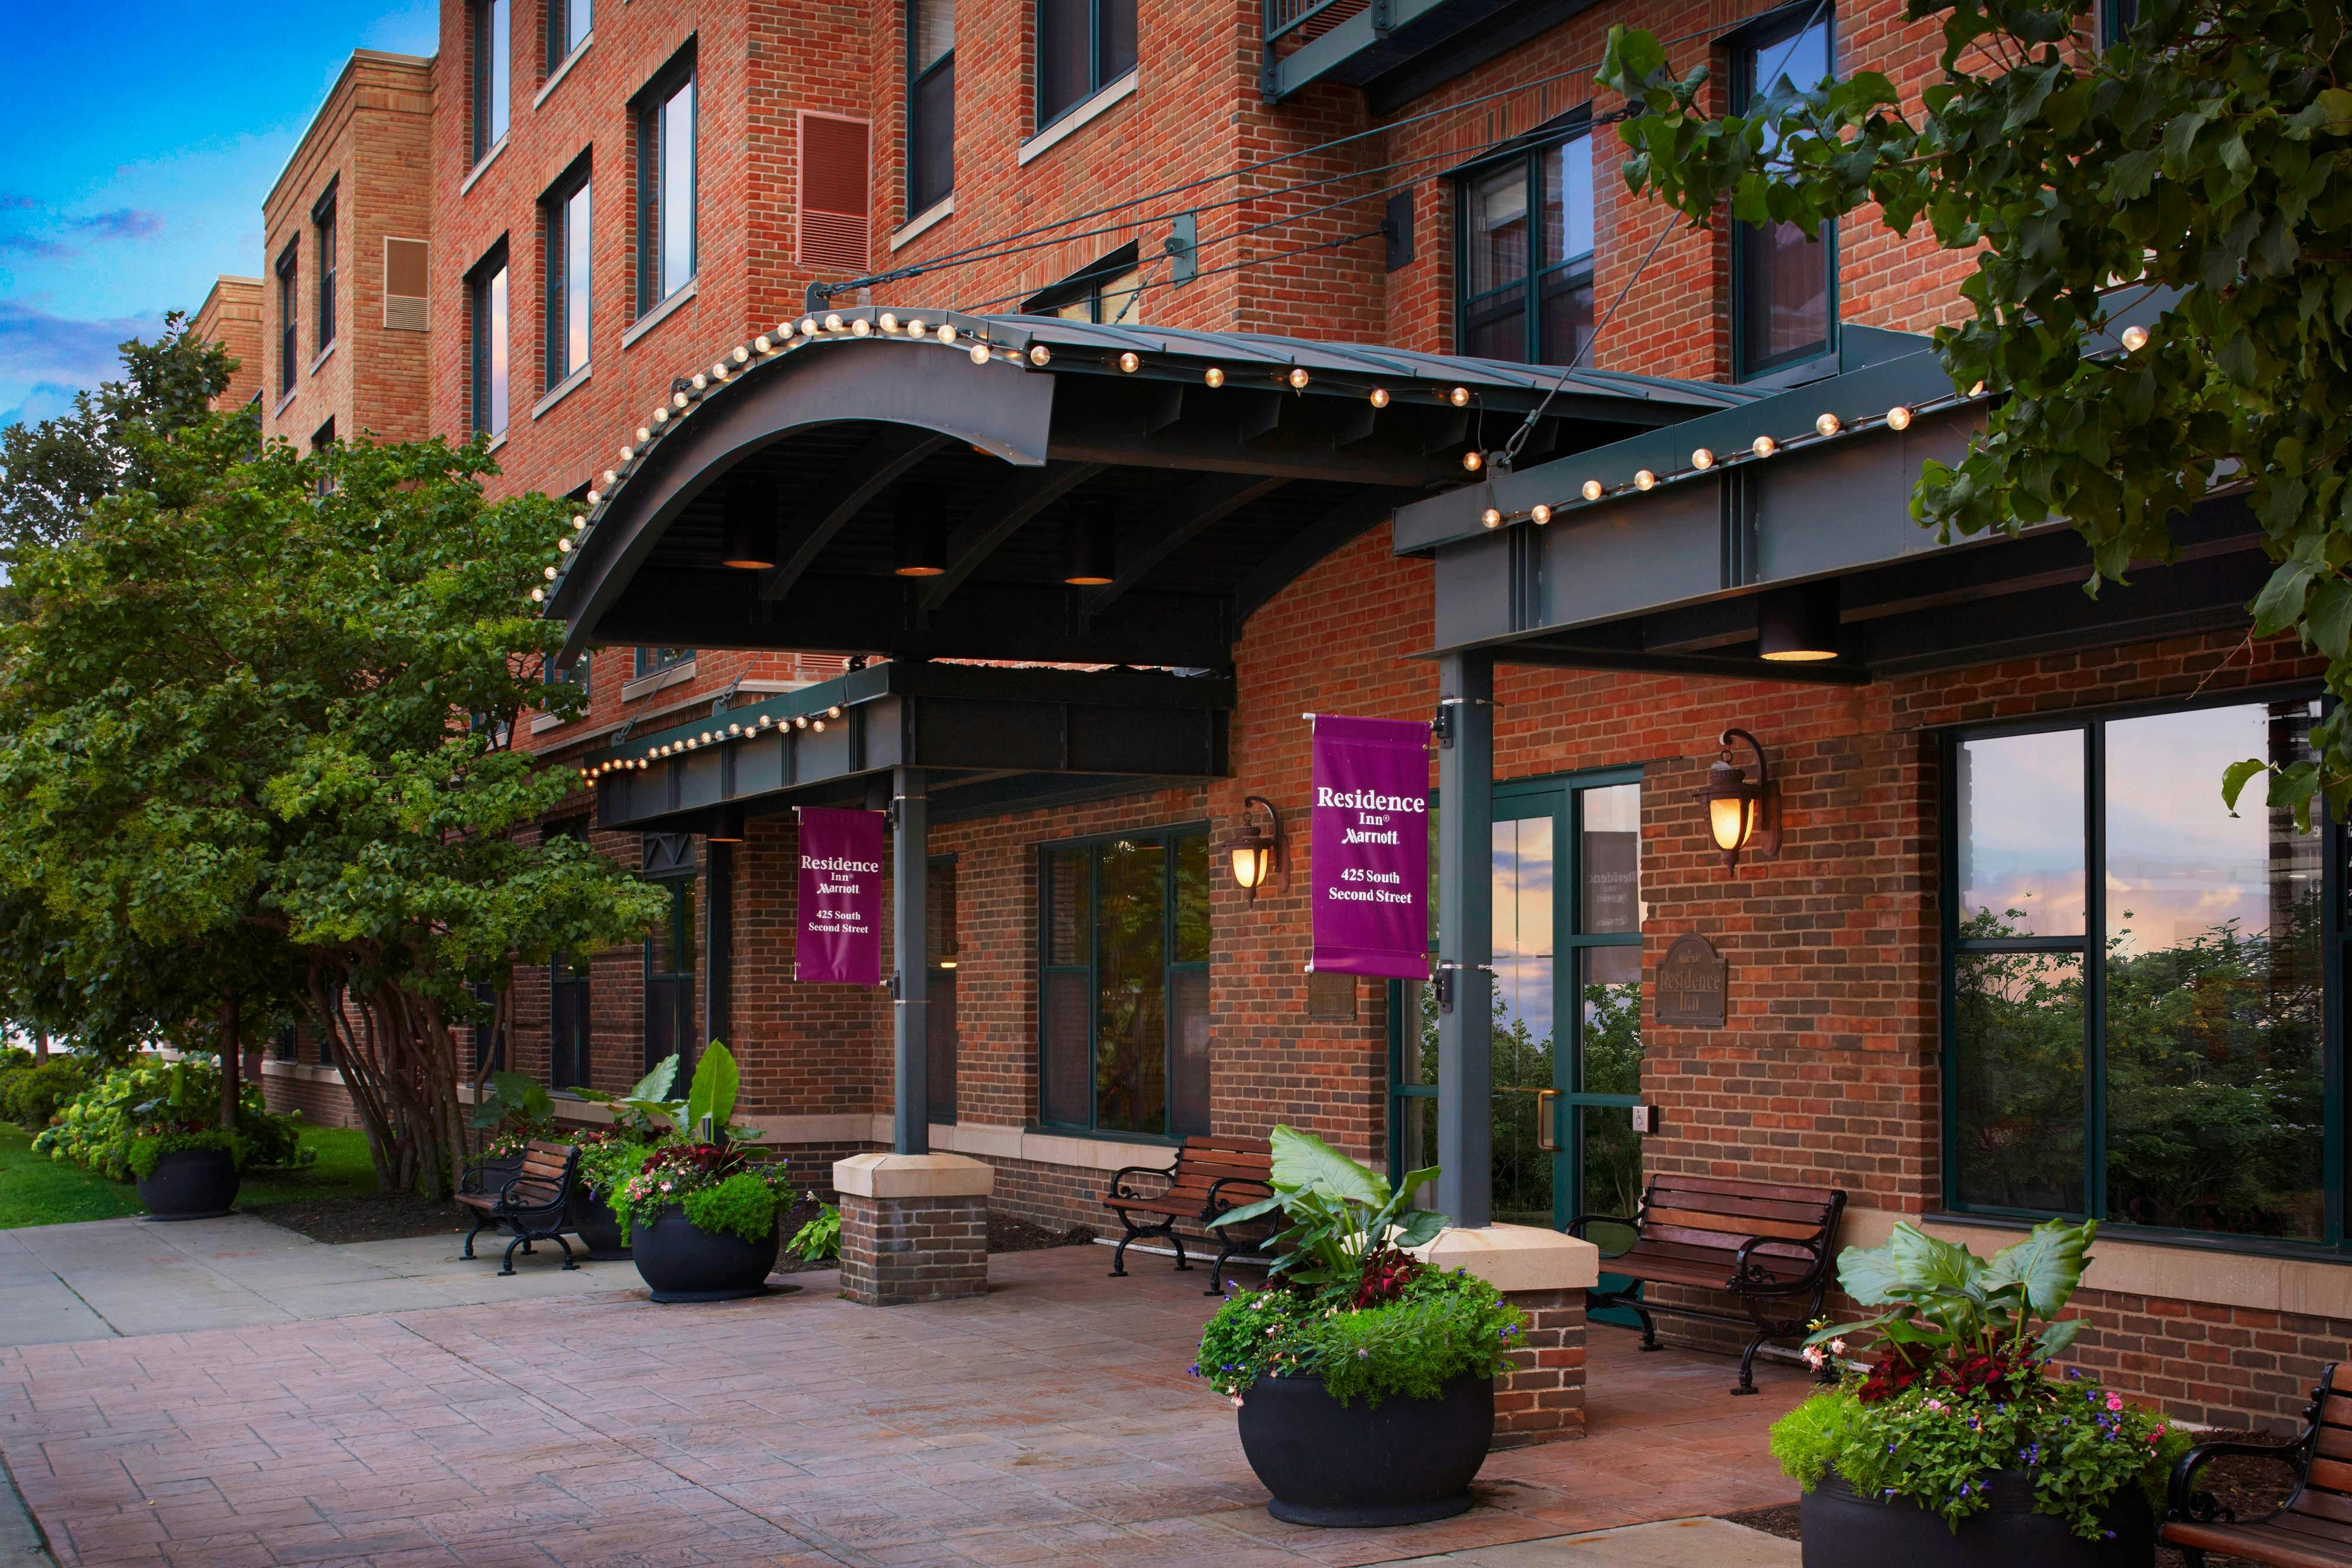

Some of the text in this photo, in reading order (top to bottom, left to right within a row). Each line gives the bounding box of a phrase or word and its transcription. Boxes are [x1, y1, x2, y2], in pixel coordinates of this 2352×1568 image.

[1317, 787, 1425, 813] Residence
[1341, 828, 1398, 845] Marriott
[801, 855, 878, 872] Residence
[1341, 868, 1400, 884] 425 South
[816, 883, 860, 894] Marriott
[1329, 887, 1412, 904] Second Street
[816, 910, 861, 920] 425 South
[808, 922, 868, 933] Second Street
[1659, 970, 1720, 992] Residence
[1679, 990, 1700, 1012] Inn
